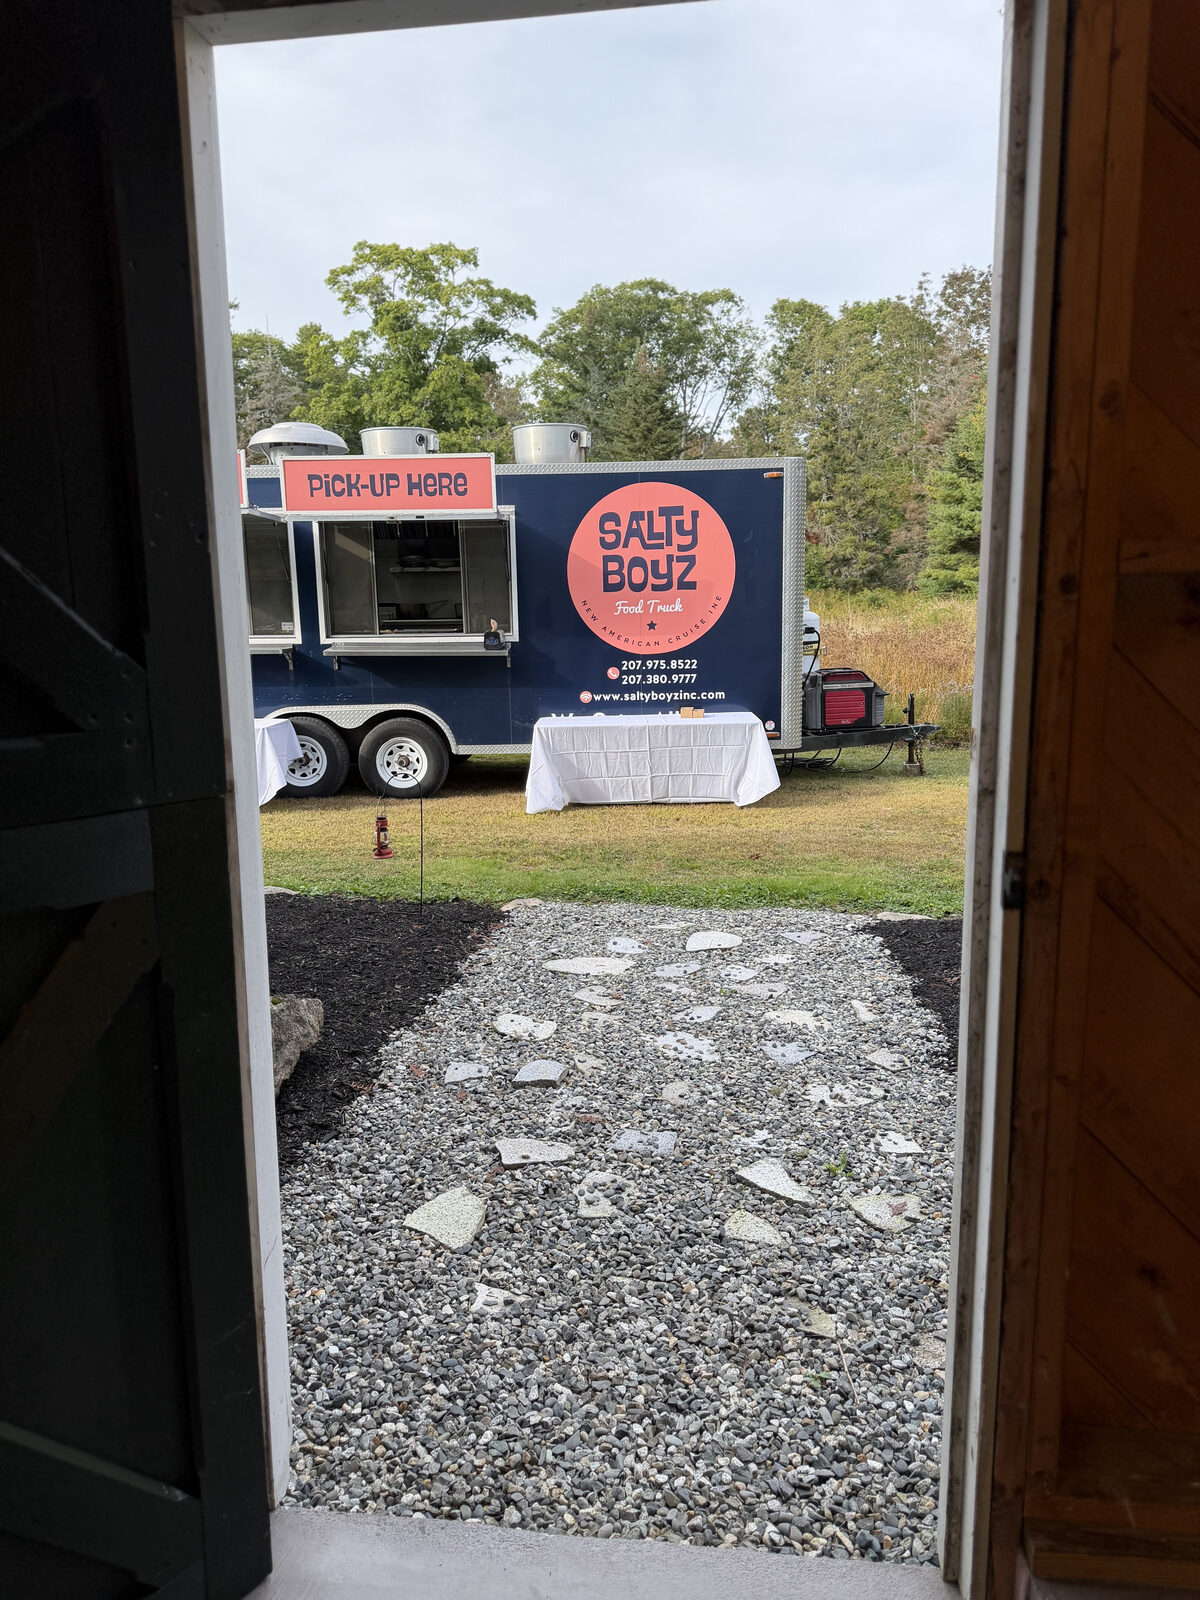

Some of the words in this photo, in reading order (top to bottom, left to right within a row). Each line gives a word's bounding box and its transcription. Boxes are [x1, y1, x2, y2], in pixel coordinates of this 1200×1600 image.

[599, 505, 700, 552] SALTY
[602, 554, 698, 593] BOYZ
[613, 599, 645, 616] Food
[647, 597, 684, 614] Truck
[581, 600, 599, 622] NEW
[601, 625, 661, 647] AMERICAN
[667, 618, 706, 644] CRUISE
[621, 659, 698, 671] 207.975.8522
[621, 673, 697, 685] 207.380.9777
[593, 690, 726, 703] www.saltyboyzinc.com
